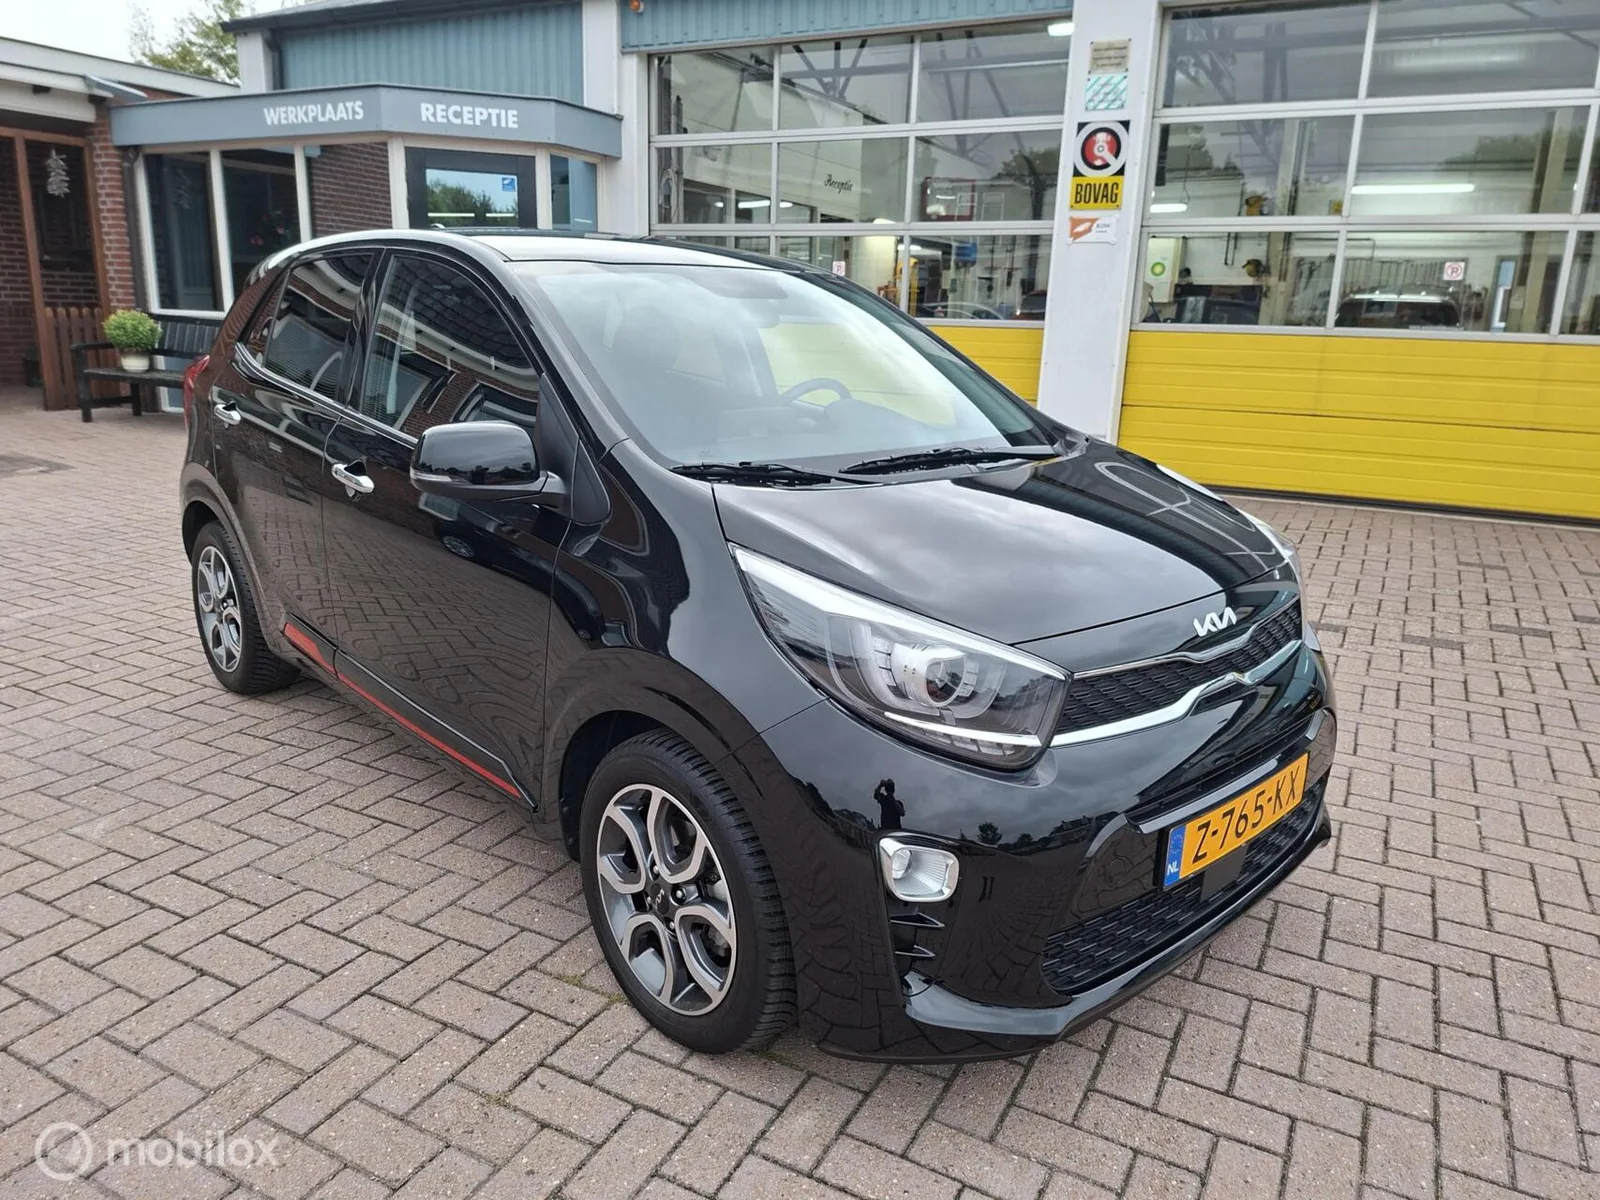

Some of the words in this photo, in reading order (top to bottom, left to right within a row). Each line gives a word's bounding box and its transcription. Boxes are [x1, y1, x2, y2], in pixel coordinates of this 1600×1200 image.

[263, 100, 364, 126] WERKPLAATS
[420, 102, 519, 128] RECEPTIE
[1075, 182, 1119, 205] BOVAG
[1193, 606, 1238, 637] KIA
[1192, 764, 1301, 865] Z-765-KX
[1166, 861, 1180, 876] NL
